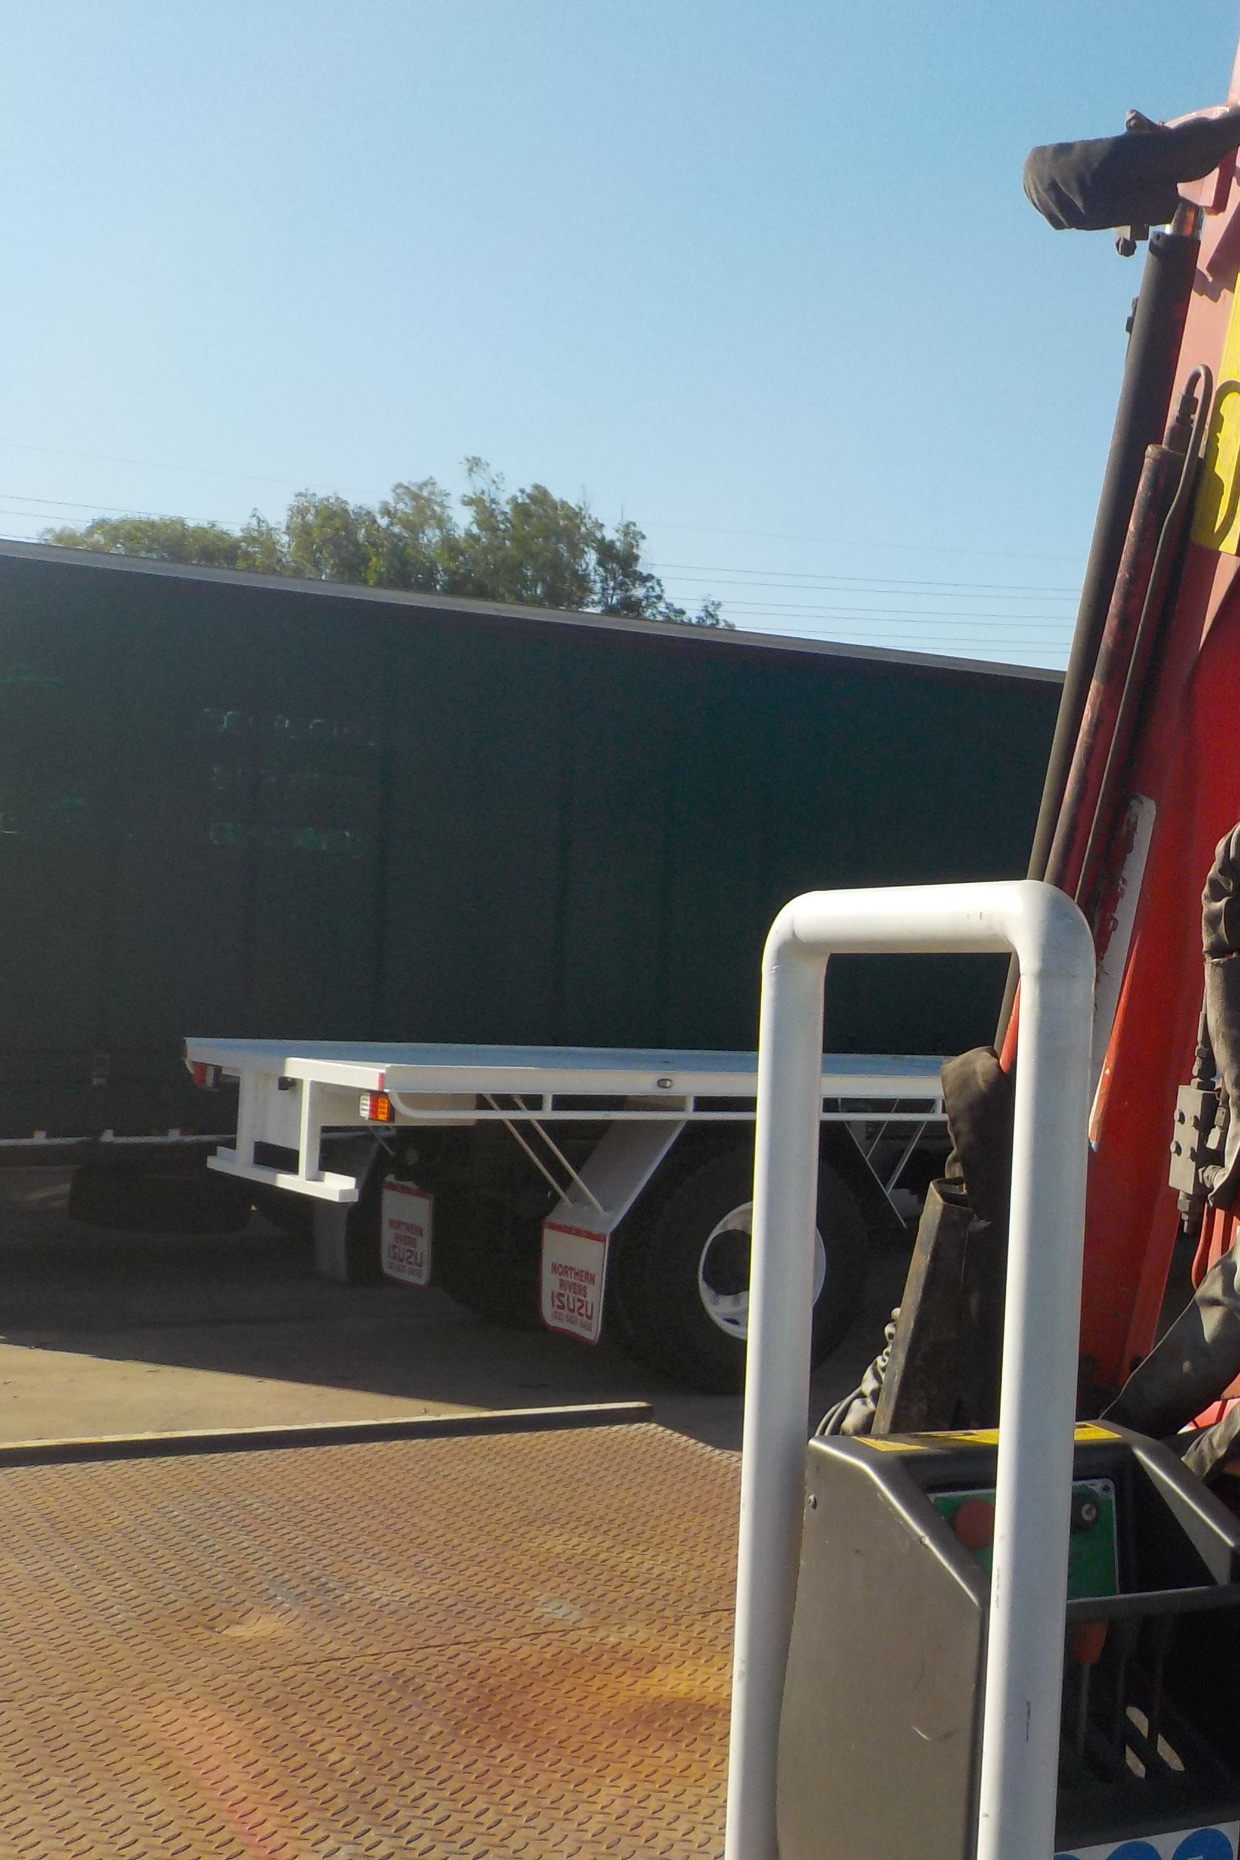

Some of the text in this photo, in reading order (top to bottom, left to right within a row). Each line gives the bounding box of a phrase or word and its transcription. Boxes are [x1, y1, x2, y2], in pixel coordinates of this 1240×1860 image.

[387, 1243, 424, 1268] ISUZU
[551, 1262, 596, 1286] NORTHERN
[559, 1278, 588, 1298] RIVERS
[551, 1290, 594, 1320] ISUZU
